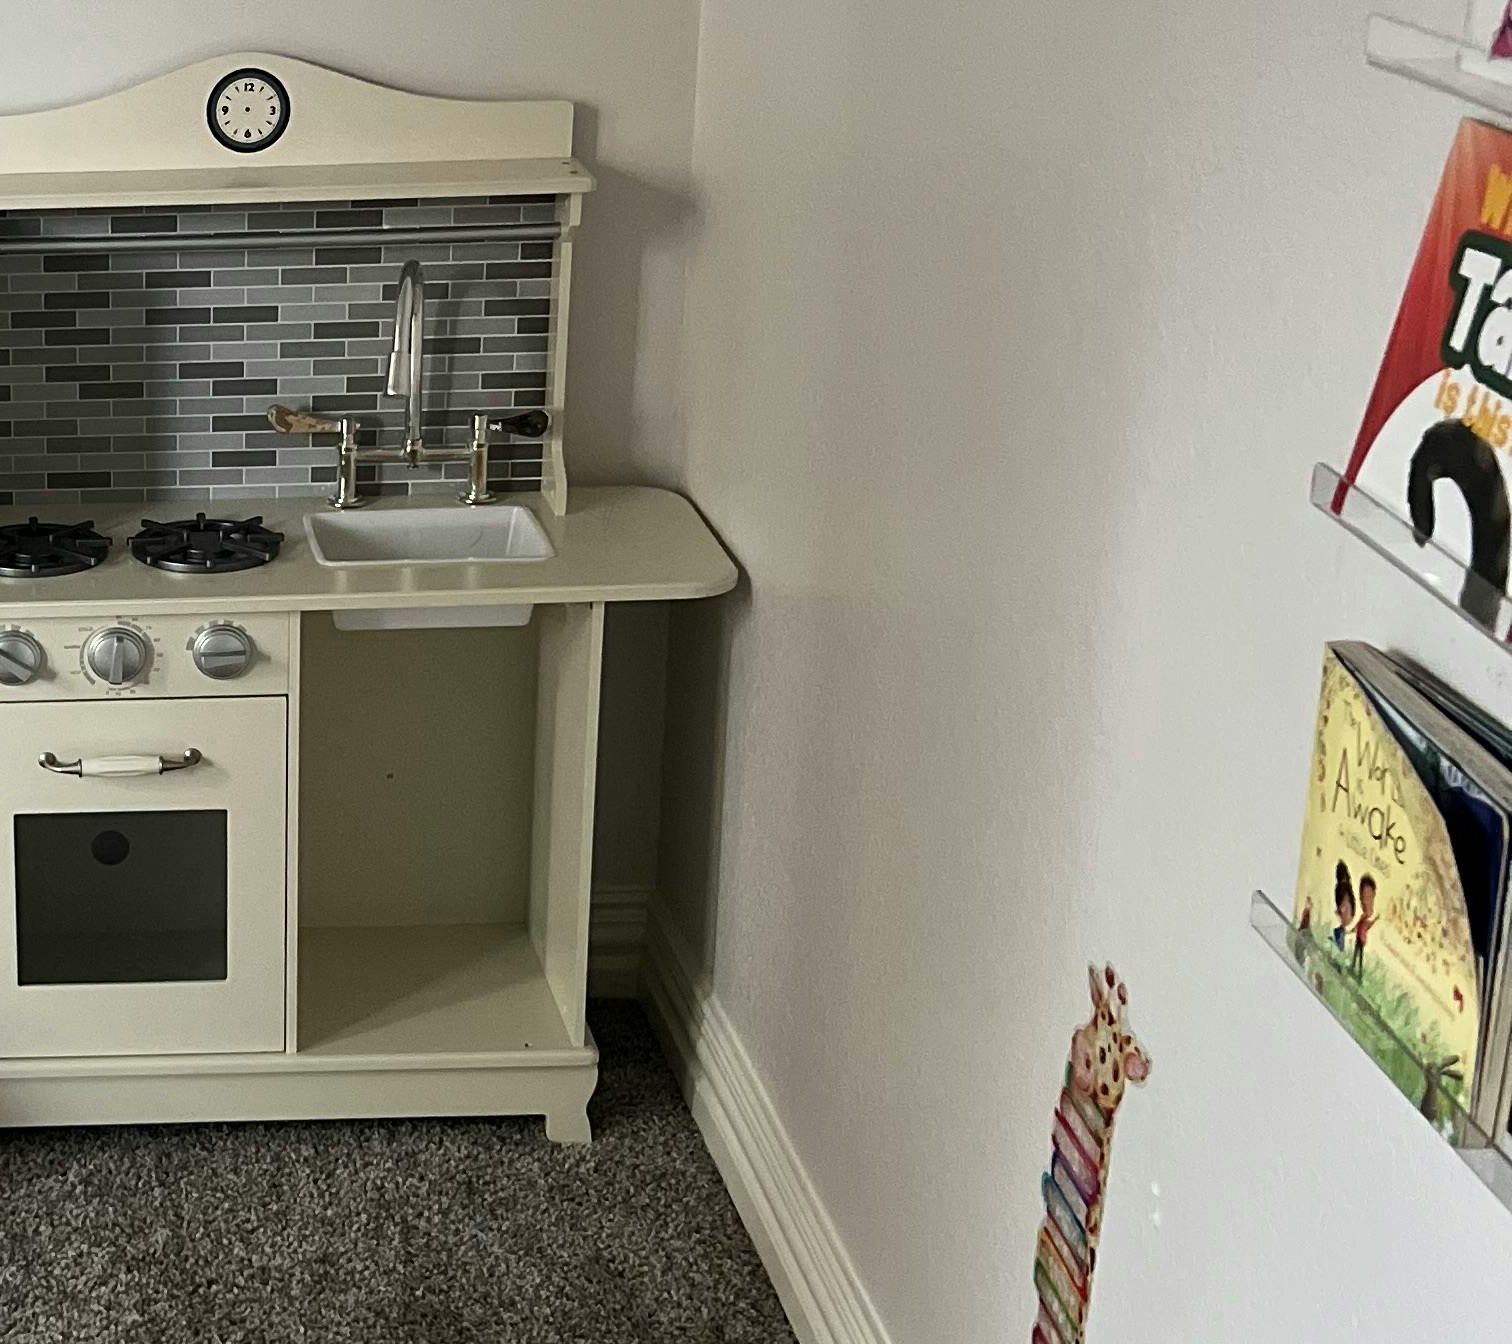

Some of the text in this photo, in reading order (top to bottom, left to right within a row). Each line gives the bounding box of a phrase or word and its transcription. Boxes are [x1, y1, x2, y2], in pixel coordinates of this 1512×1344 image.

[244, 83, 255, 92] 12
[222, 106, 229, 115] 9
[269, 106, 276, 115] 3
[244, 129, 251, 138] 6
[1332, 747, 1406, 864] Awake
